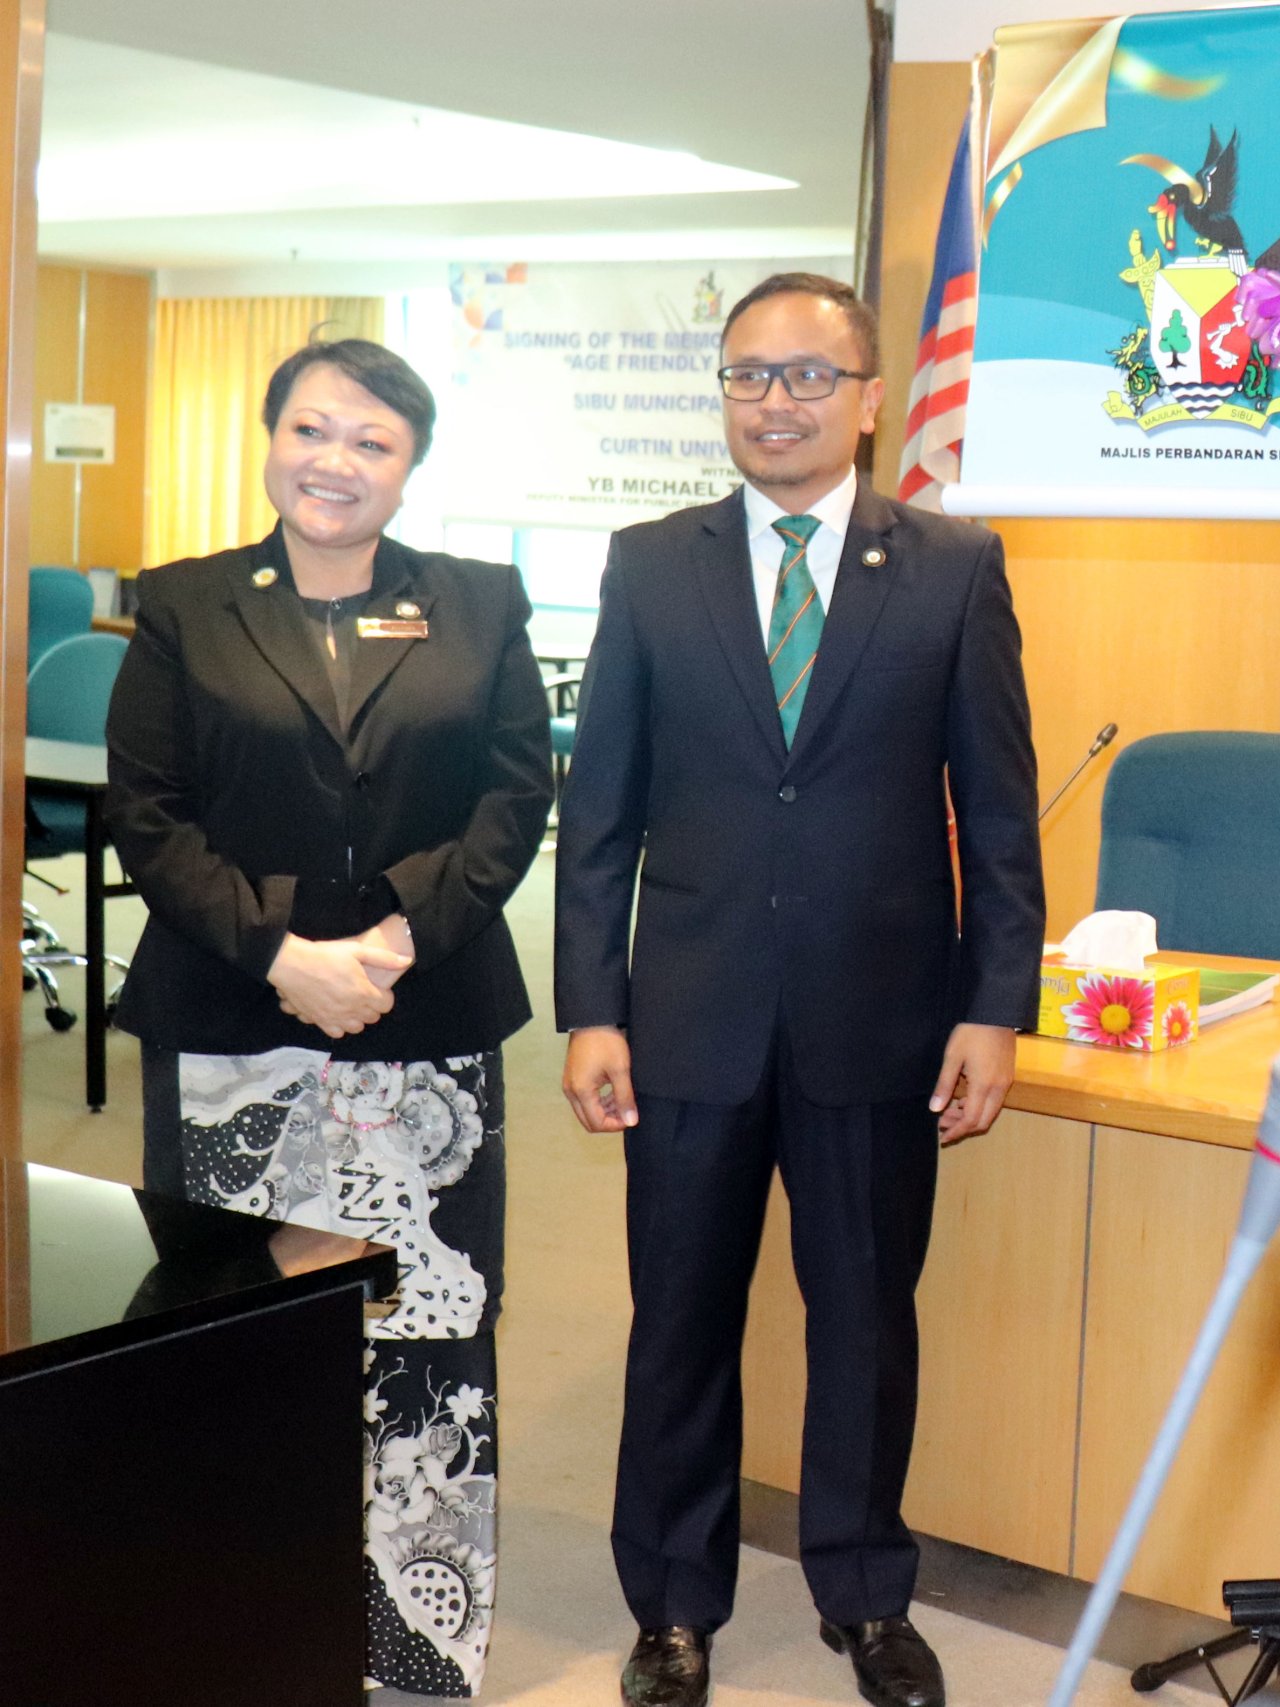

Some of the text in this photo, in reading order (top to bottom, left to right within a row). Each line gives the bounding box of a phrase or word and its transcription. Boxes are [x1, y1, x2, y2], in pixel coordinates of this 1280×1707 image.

[503, 331, 721, 350] SIGNING OF THE MEMO
[617, 355, 713, 373] FRIENDLY
[573, 392, 721, 412] SIBU MUNICIPA
[1144, 408, 1254, 426] MAJULAH SIBU
[599, 437, 729, 458] CURTIN UNIV
[1100, 447, 1151, 459] MAJLIS
[1155, 448, 1264, 460] PERBANDARAN
[588, 477, 615, 493] YB
[622, 478, 720, 498] MICHAEL
